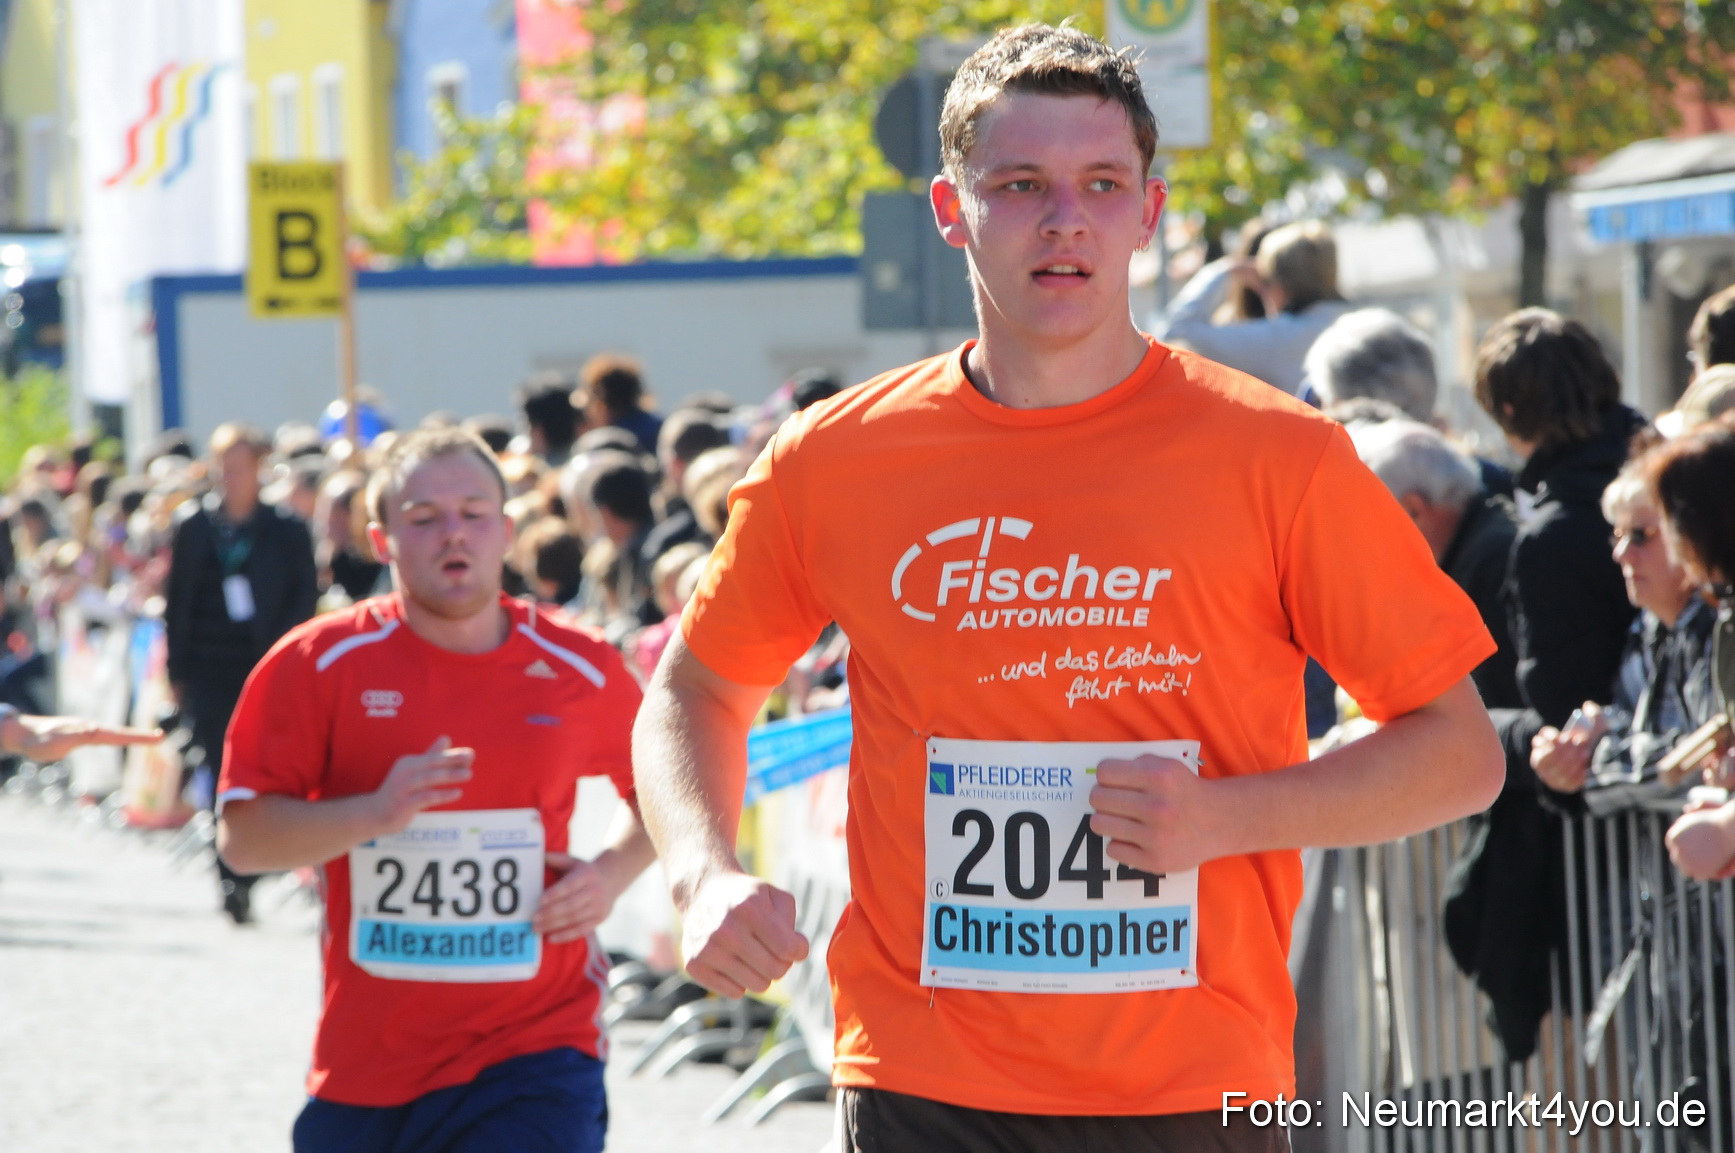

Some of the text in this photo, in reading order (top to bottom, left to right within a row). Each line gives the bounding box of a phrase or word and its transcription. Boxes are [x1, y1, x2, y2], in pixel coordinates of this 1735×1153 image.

[276, 211, 322, 279] B
[937, 554, 1172, 607] Fischer
[957, 607, 1150, 631] AUTOMOBILE
[1055, 646, 1099, 672] das
[1066, 676, 1131, 709] fährt
[958, 764, 1073, 788] PFLEIDERER
[959, 788, 1074, 802] AKTIENGESELLSCHAFT
[375, 857, 520, 918] 2438
[367, 923, 533, 956] Alexander
[933, 905, 1188, 968] Christopher
